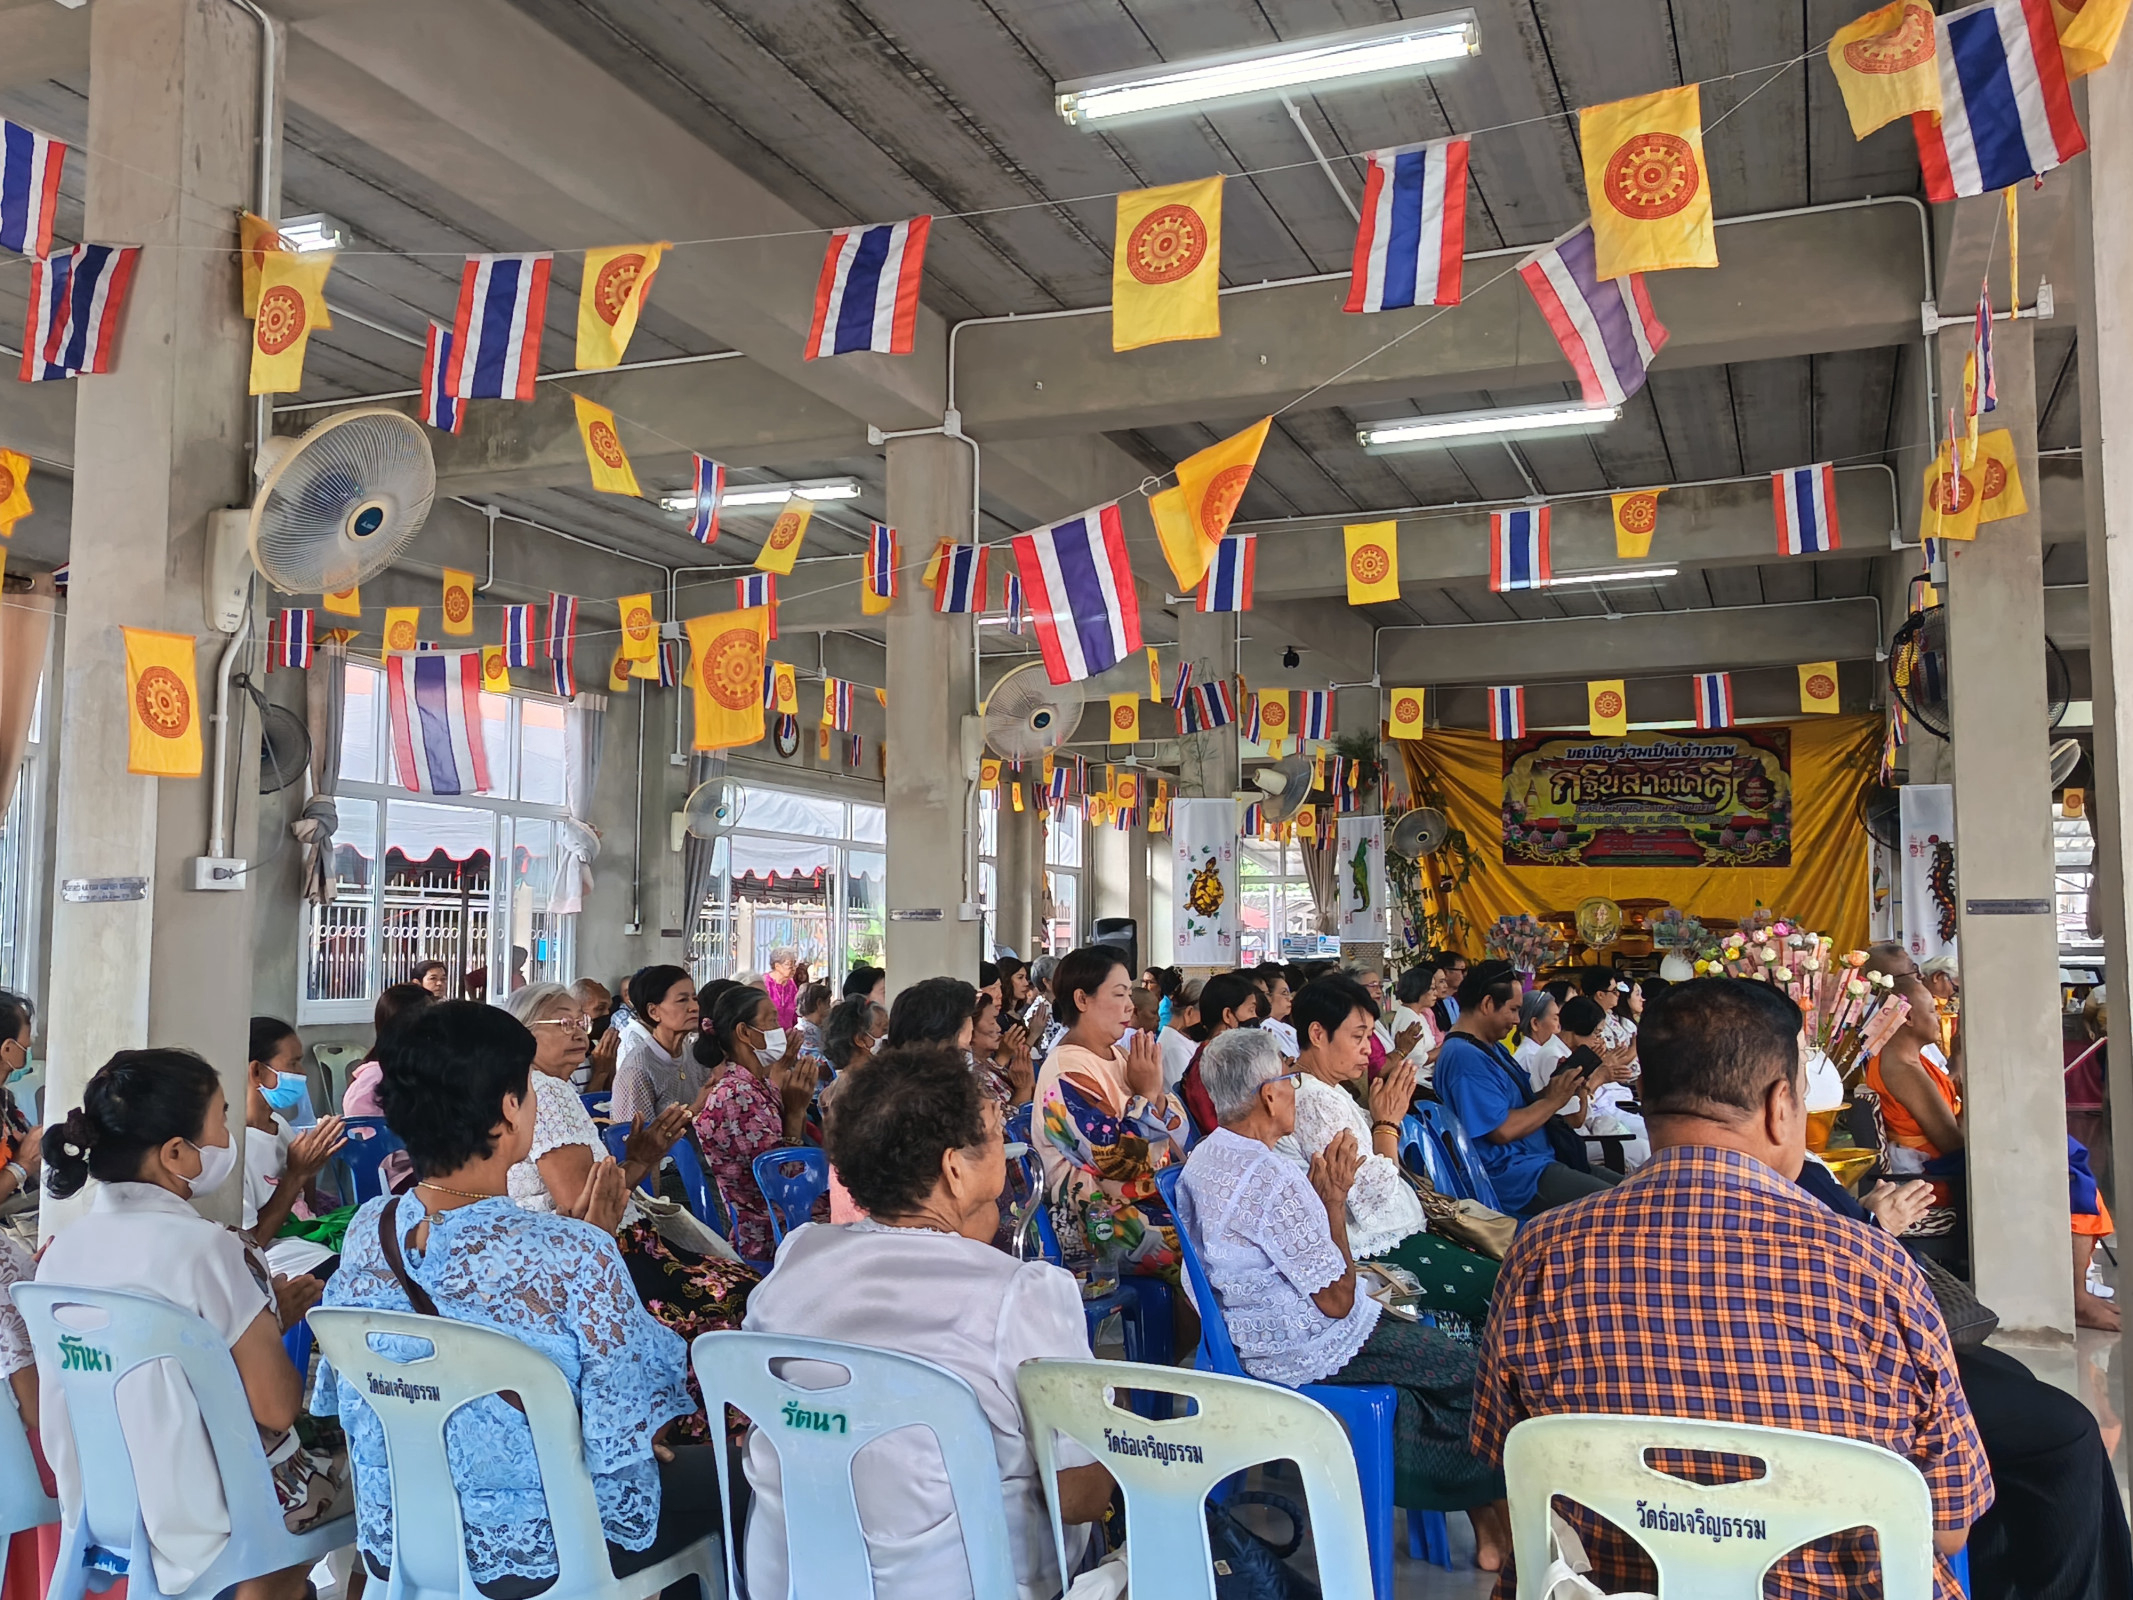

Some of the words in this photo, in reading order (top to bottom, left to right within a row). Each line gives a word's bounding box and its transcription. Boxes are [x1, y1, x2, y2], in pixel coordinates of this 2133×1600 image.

[1550, 760, 1734, 812] กฐินสามัคคี
[781, 1401, 846, 1434] รัตนา
[1104, 1427, 1204, 1466] วัดธ่อเจริญธรรม
[1636, 1499, 1767, 1543] วัดธ่อเจริญธรรม
